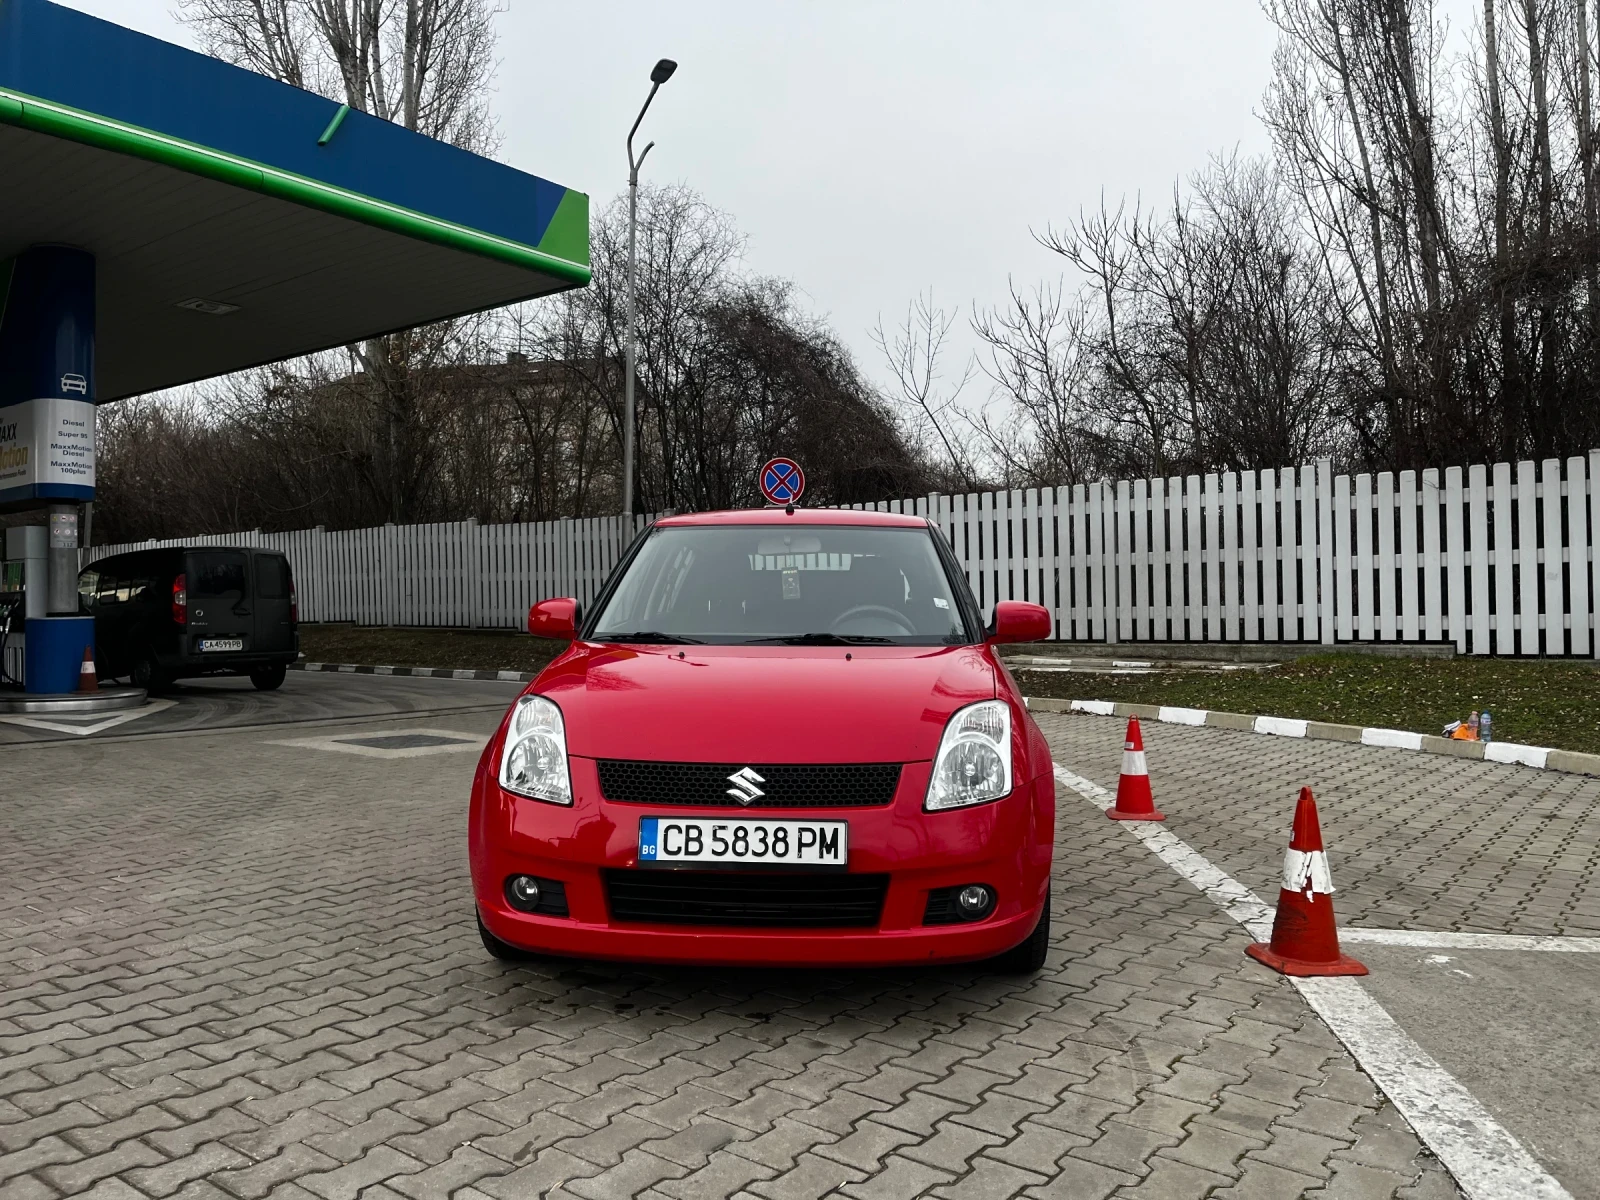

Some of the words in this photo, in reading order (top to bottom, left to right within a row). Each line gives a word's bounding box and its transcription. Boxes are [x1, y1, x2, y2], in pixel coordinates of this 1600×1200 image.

[62, 419, 85, 427] Diesel
[51, 443, 92, 452] MaxxMotion
[51, 461, 92, 469] MaxxMotion
[61, 467, 86, 475] 100plus
[642, 845, 655, 855] BG
